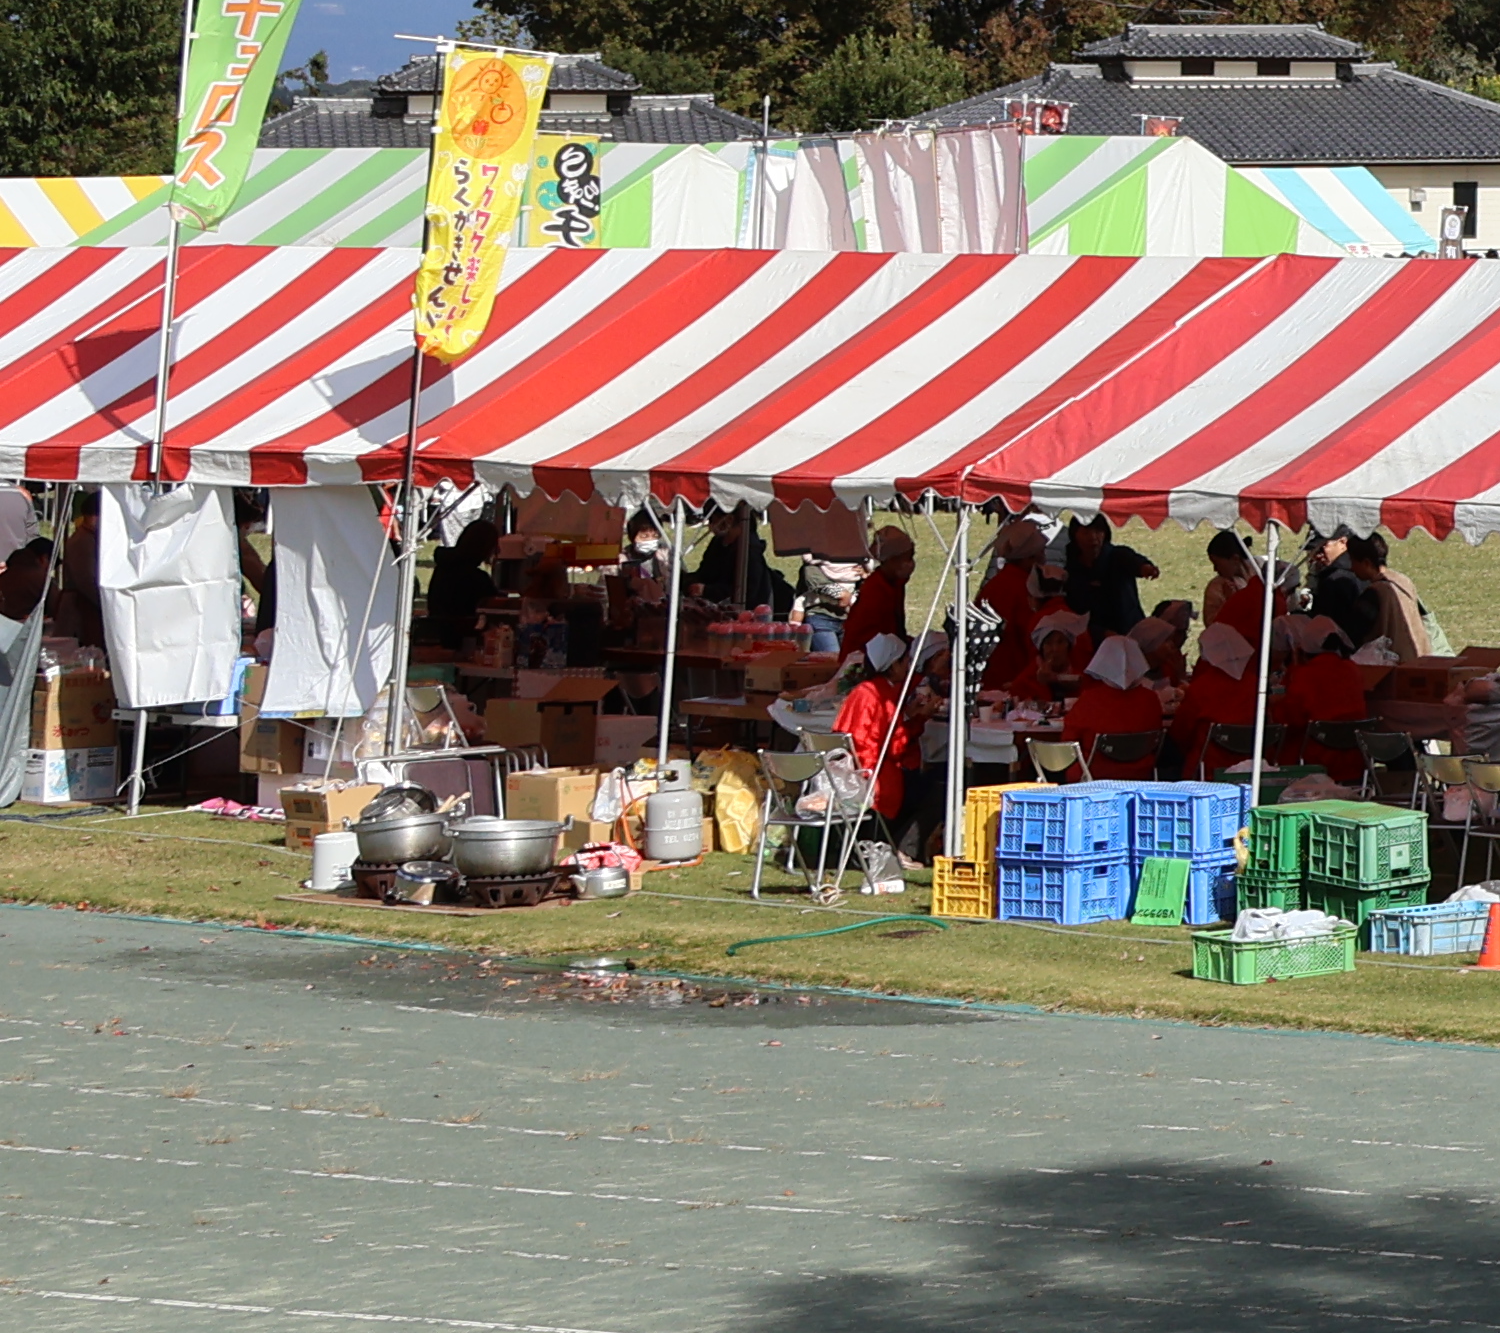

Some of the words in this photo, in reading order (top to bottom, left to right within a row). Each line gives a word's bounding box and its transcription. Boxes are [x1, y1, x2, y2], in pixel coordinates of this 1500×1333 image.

[425, 159, 474, 333] らくがきせんべ
